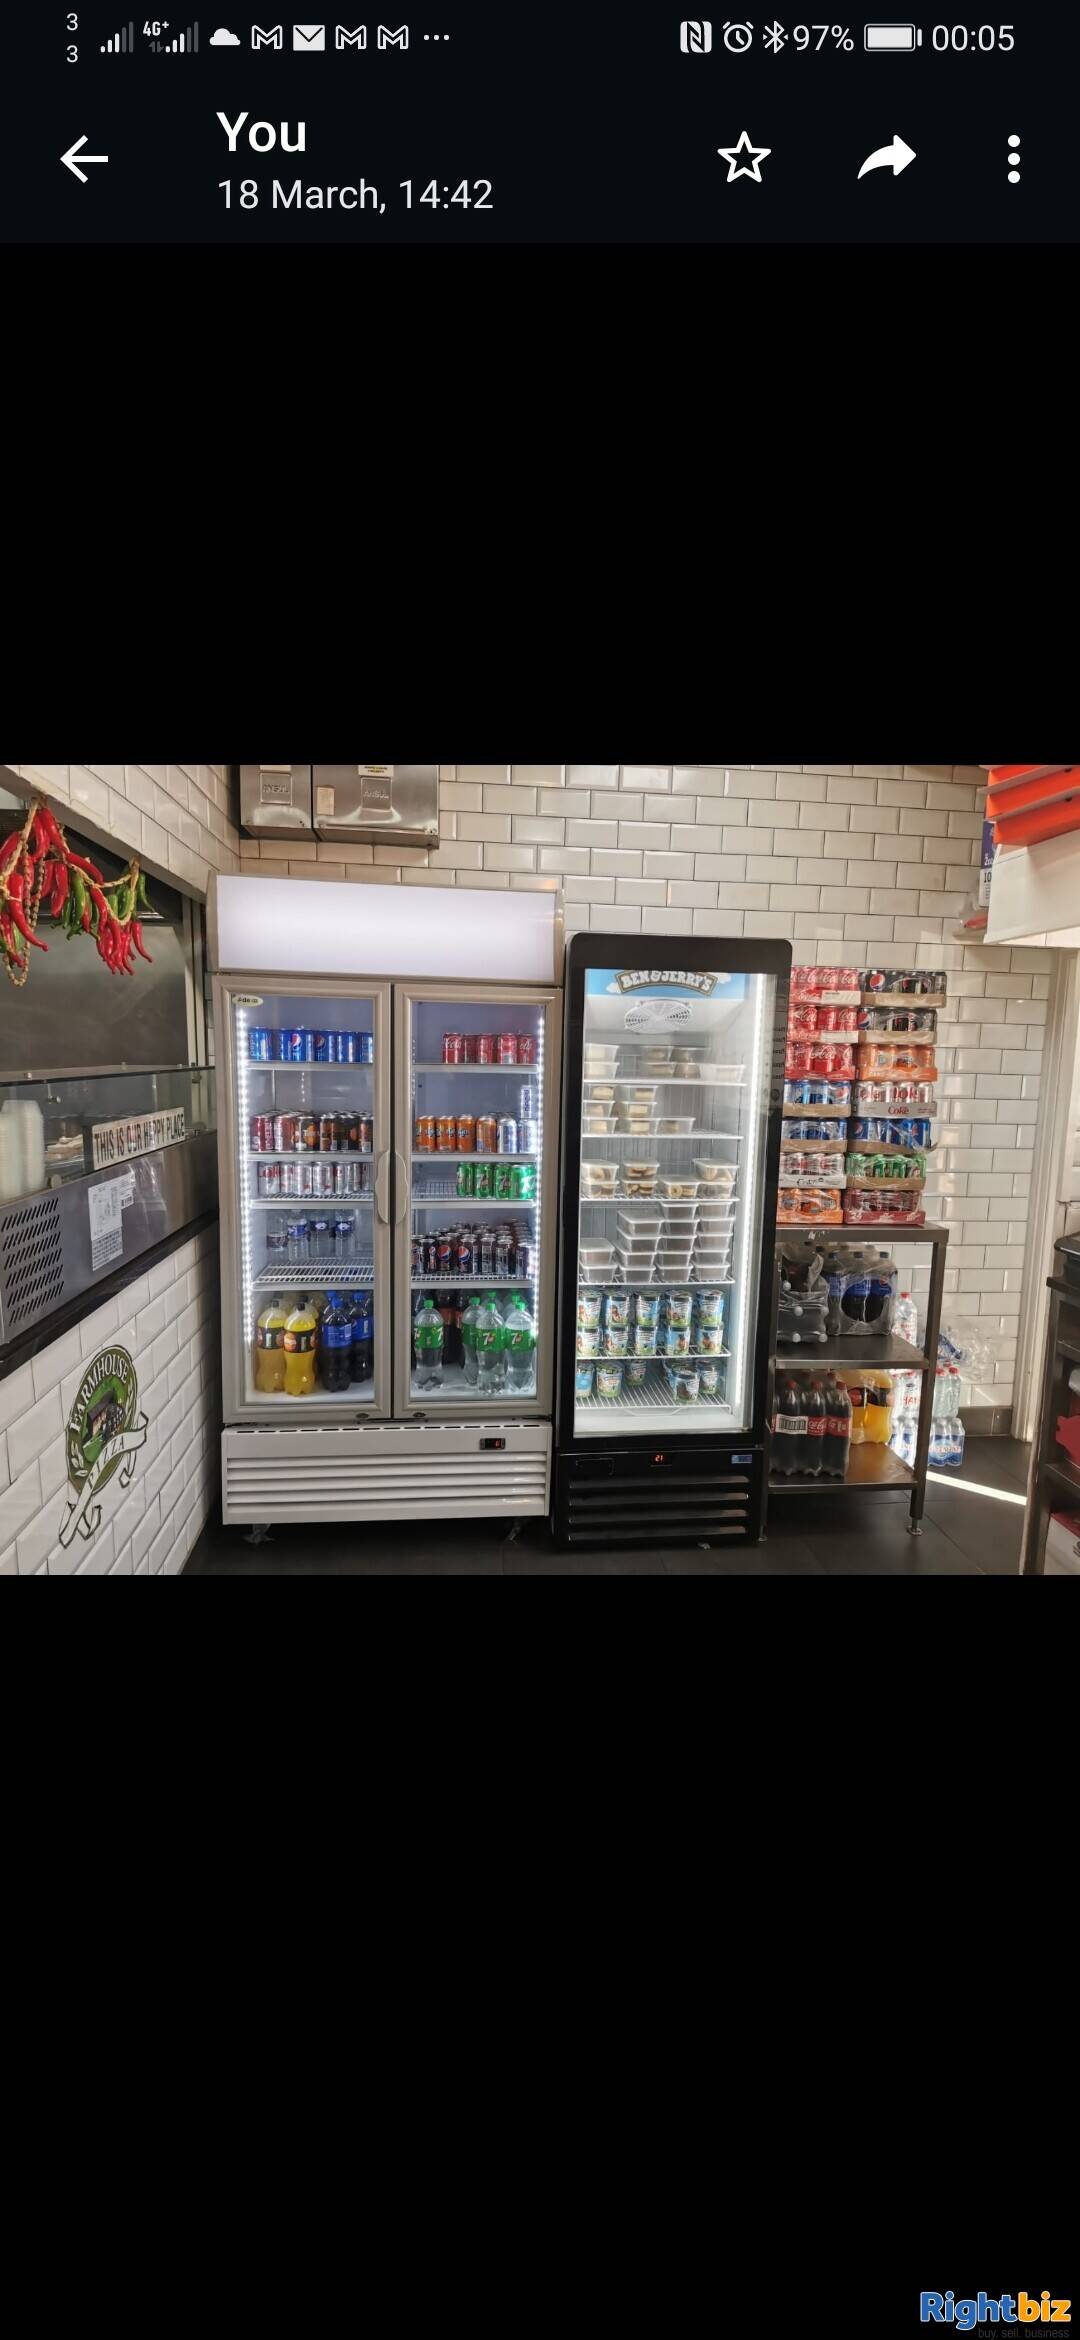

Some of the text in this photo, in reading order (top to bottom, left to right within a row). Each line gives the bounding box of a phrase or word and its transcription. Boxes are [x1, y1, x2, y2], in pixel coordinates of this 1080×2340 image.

[95, 1113, 185, 1163] THIS IS OUR HAPPY PLACE
[70, 1353, 129, 1432] FARMHOUSE
[88, 1435, 125, 1490] PIZZA
